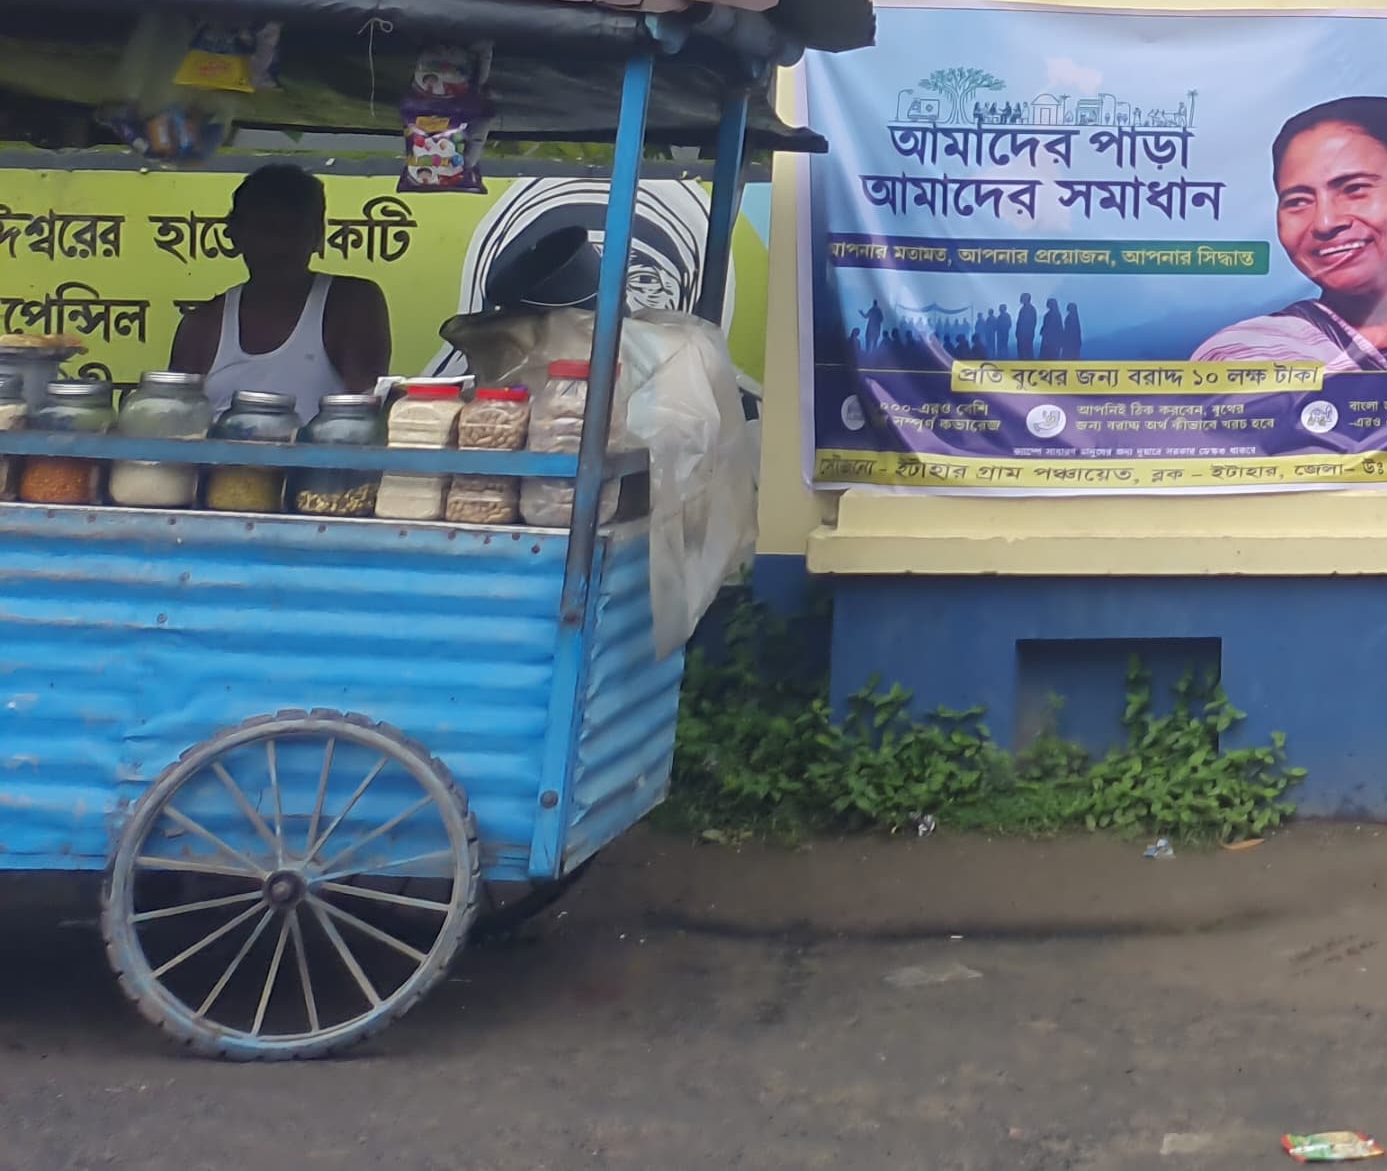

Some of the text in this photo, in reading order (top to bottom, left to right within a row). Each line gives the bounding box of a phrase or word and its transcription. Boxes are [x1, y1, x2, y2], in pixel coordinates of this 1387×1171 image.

[887, 125, 1196, 173] আমাদের পাড়া
[859, 174, 1226, 222] আমাদের সমাধান
[312, 195, 418, 263] কটি
[894, 245, 952, 267] মতামত,
[959, 246, 1028, 266] আপনার
[1034, 248, 1116, 269] প্রয়োজন,
[1122, 249, 1192, 268] আপনার
[1197, 244, 1255, 268] সিদ্ধান্ত
[0, 281, 151, 343] পেন্সিল
[957, 361, 1319, 391] প্রতি বুথের জন্য বরাদ্দ ১০ লক্ষ টাকা
[1130, 401, 1155, 416] ঠিক
[894, 459, 970, 481] ইটাহার
[976, 466, 1024, 482] গ্রাম
[1032, 467, 1140, 485] পঞ্চায়েত,
[1150, 467, 1184, 483] ব্লক
[1210, 463, 1285, 481] ইটাহার,
[1363, 458, 1385, 476] উঃ
